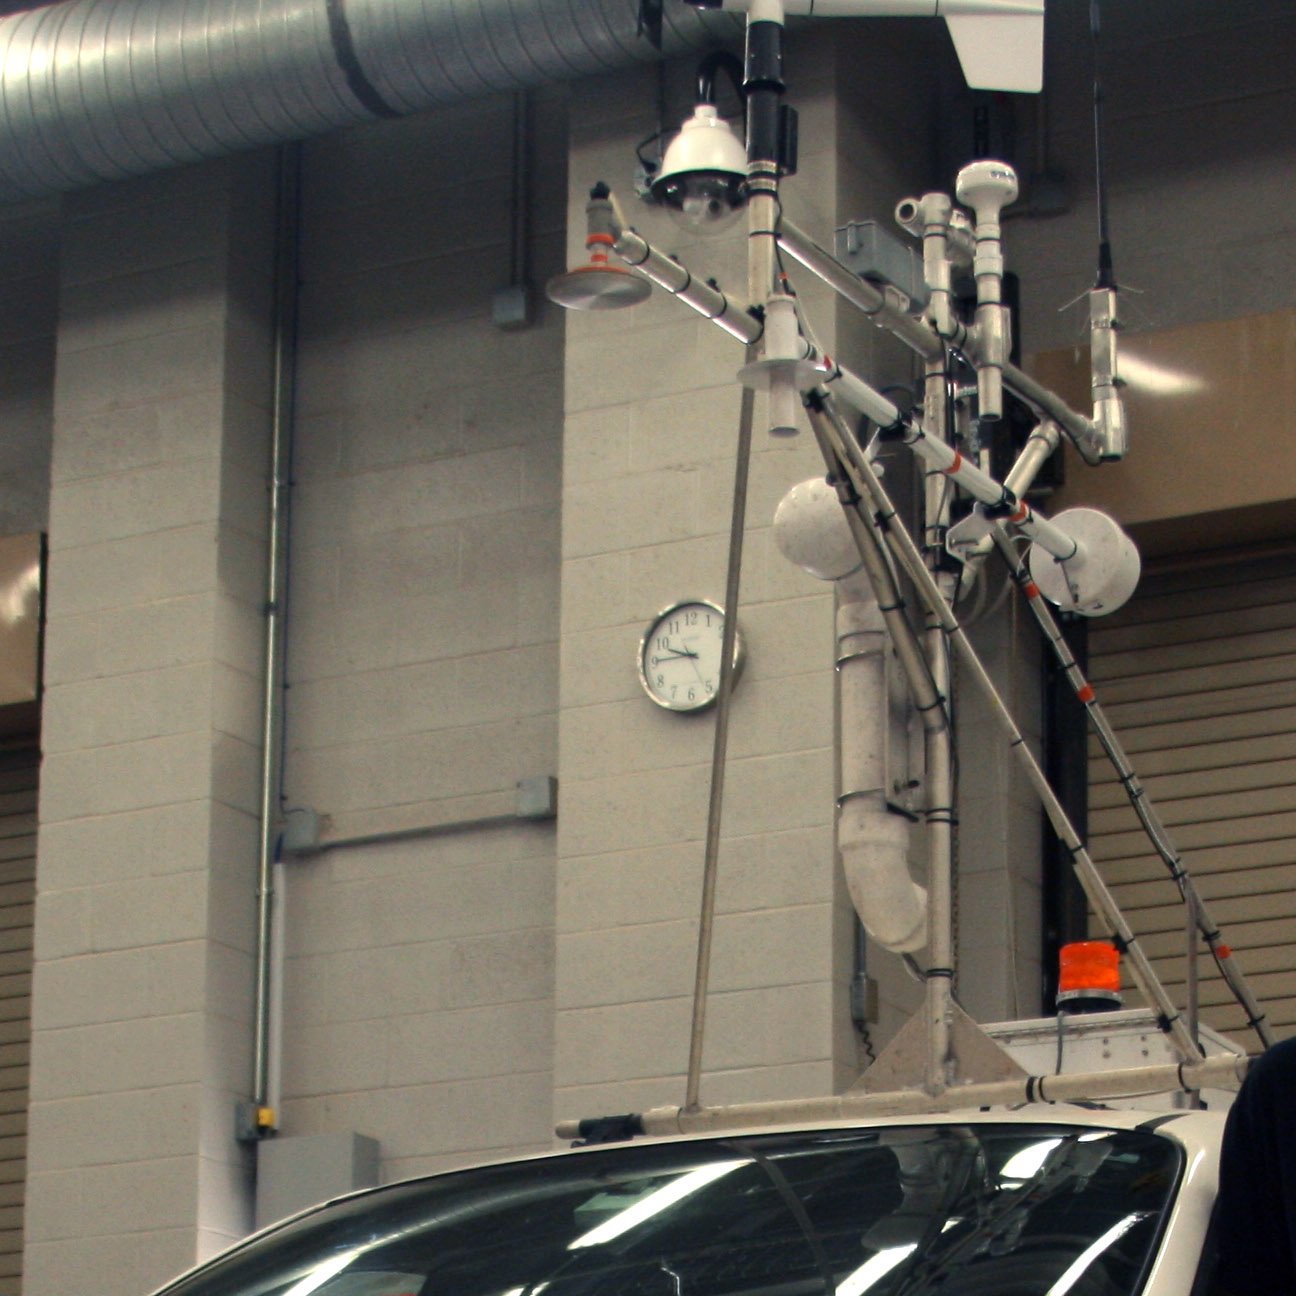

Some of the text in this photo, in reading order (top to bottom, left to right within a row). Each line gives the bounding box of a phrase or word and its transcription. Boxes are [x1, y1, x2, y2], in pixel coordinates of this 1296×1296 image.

[684, 612, 698, 626] 12
[705, 614, 711, 628] 1
[669, 621, 680, 635] 11
[656, 637, 669, 651] 10
[651, 656, 658, 669] 9
[657, 675, 664, 688] 8
[705, 680, 713, 693] 5
[670, 686, 677, 699] 7
[688, 688, 695, 700] 6
